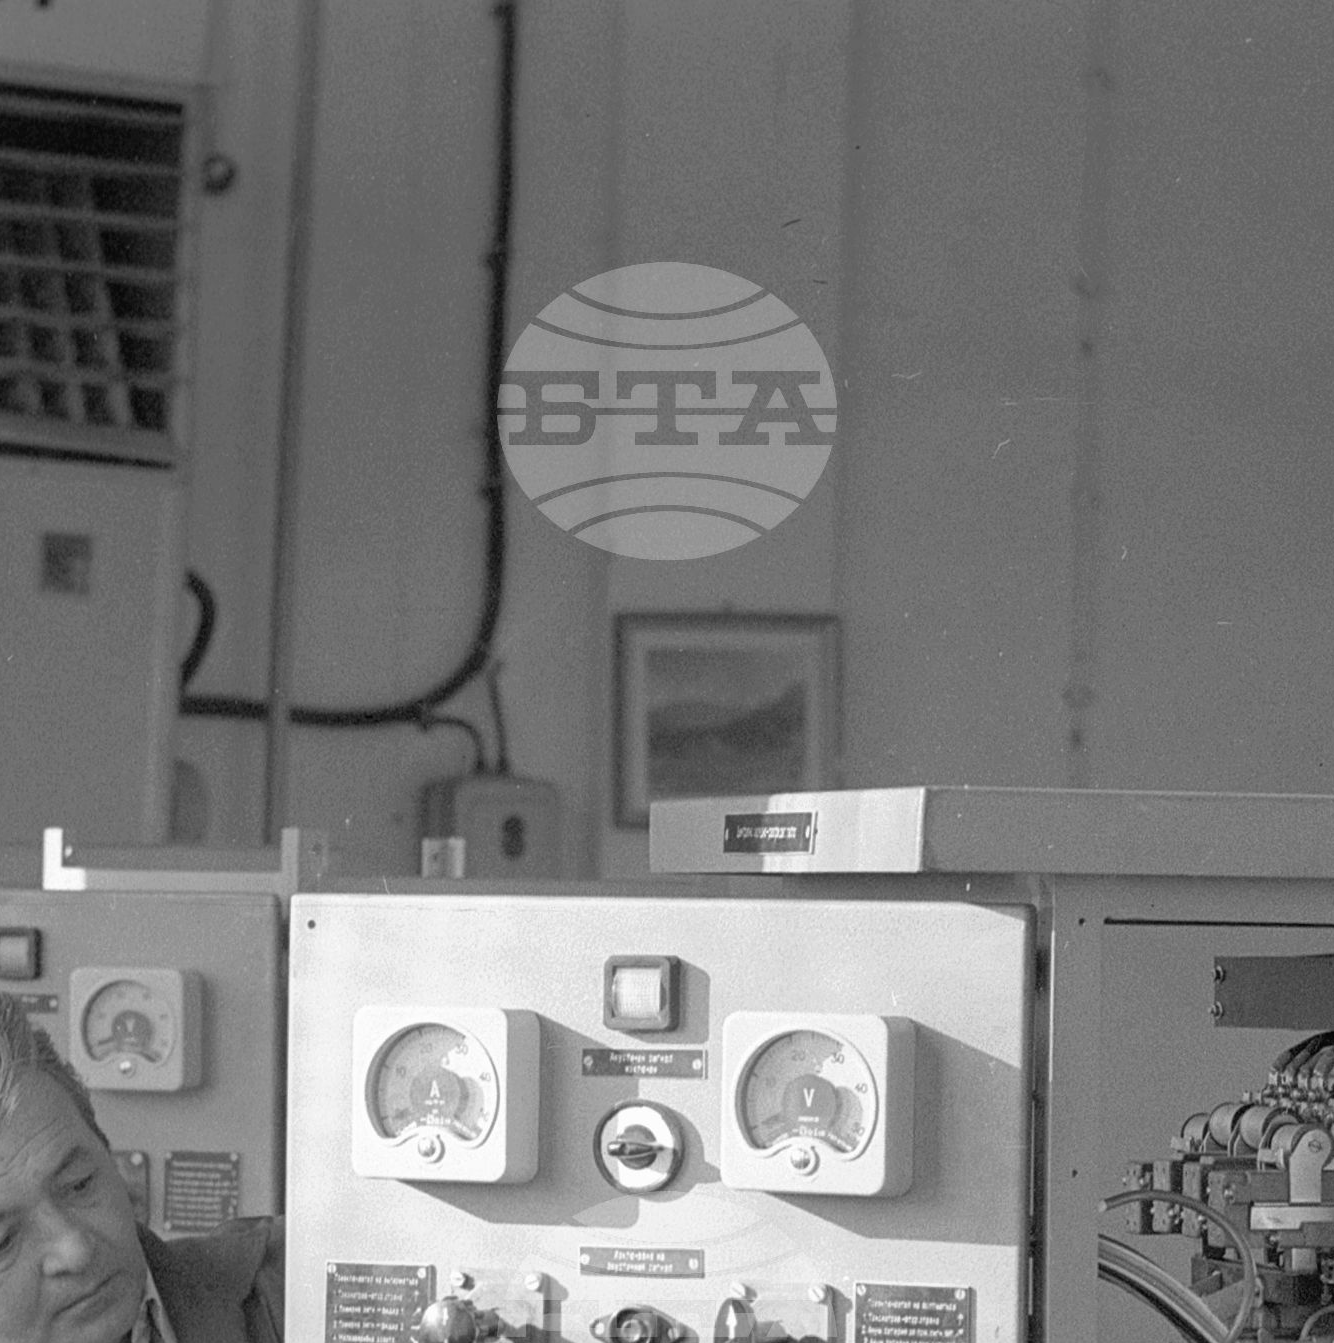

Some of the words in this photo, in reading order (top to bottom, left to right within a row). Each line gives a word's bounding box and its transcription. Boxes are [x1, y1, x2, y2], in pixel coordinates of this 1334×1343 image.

[831, 1053, 845, 1065] 30
[429, 1079, 441, 1098] A
[855, 1083, 868, 1094] 40
[803, 1088, 815, 1108] V
